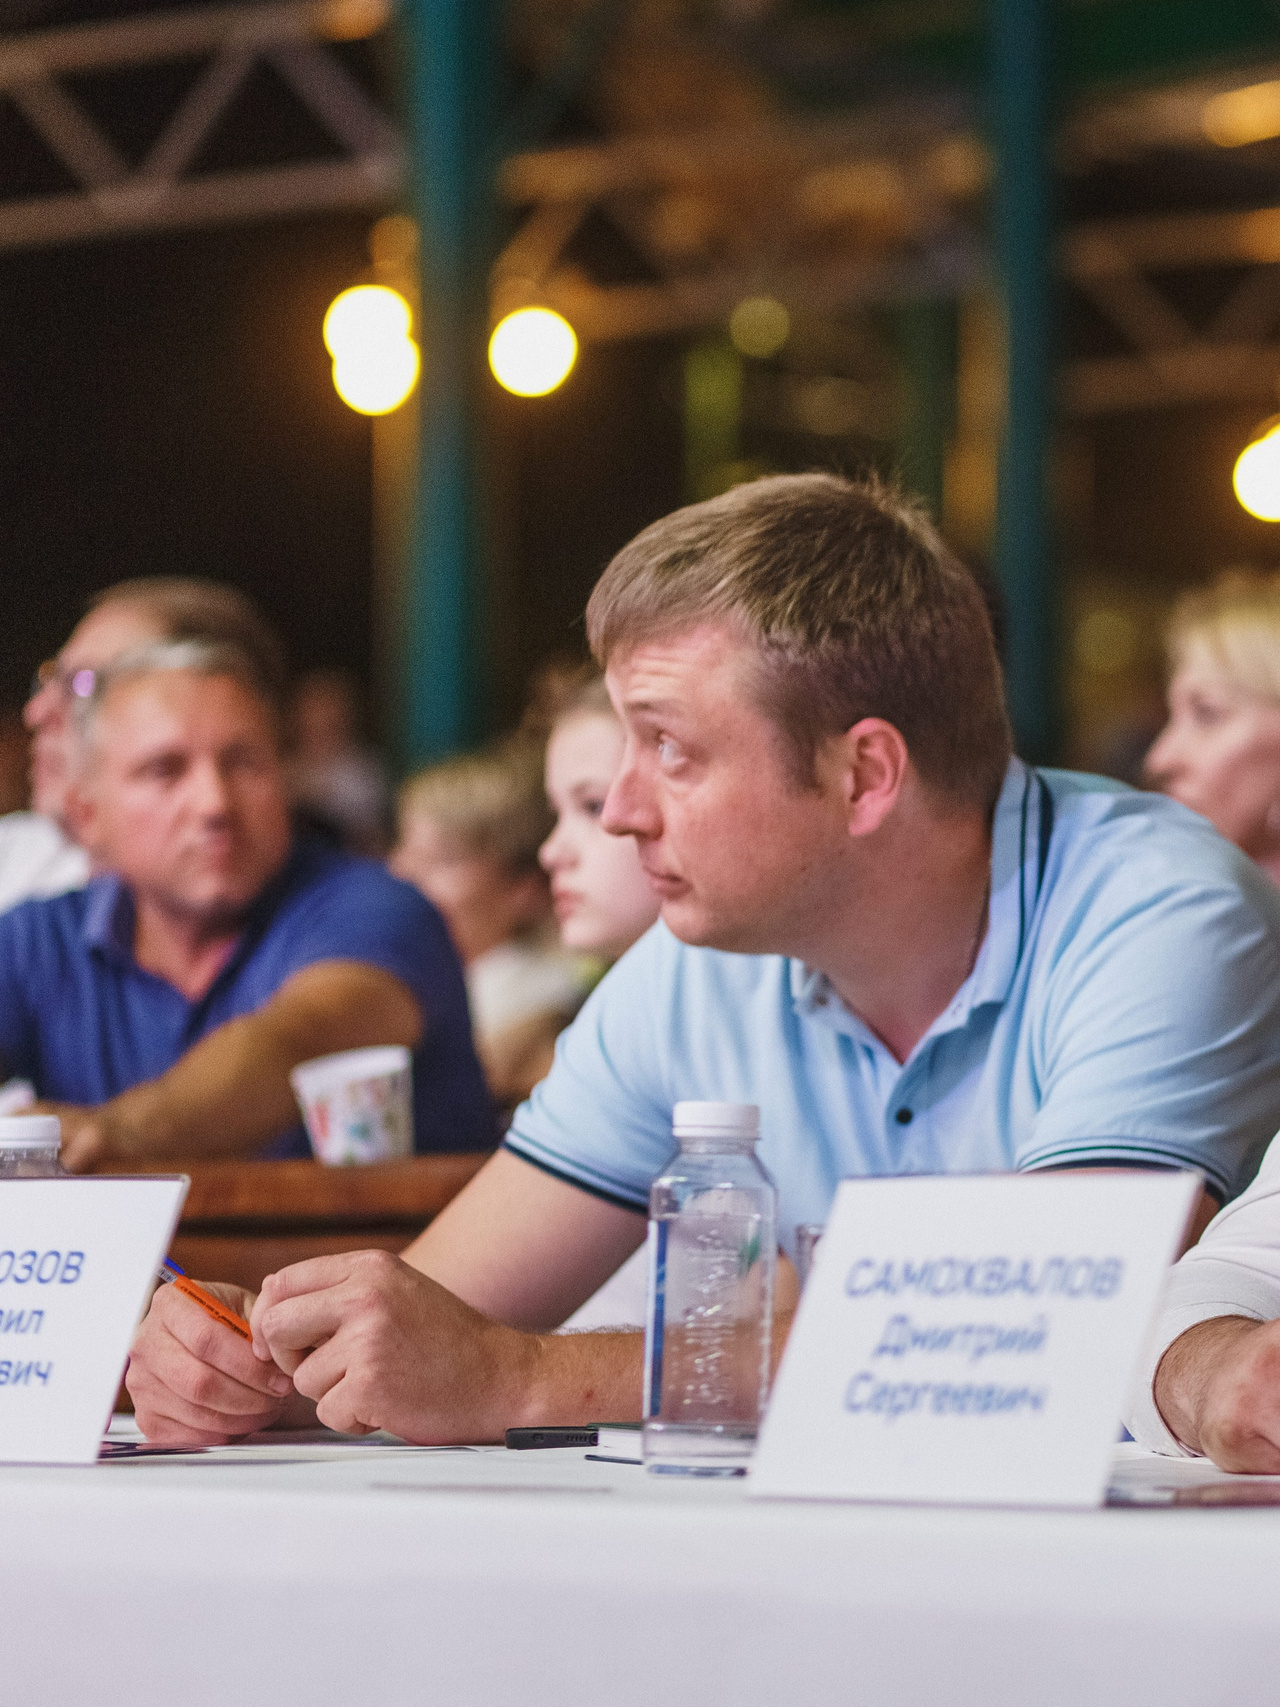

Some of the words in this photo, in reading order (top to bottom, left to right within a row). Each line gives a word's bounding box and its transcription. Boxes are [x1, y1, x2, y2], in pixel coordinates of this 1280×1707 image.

[844, 1256, 1125, 1298] САМОХВАЛОВ
[0, 1309, 45, 1334] ил
[872, 1312, 1049, 1364] Дмитрий
[844, 1371, 1048, 1422] Сергеевич
